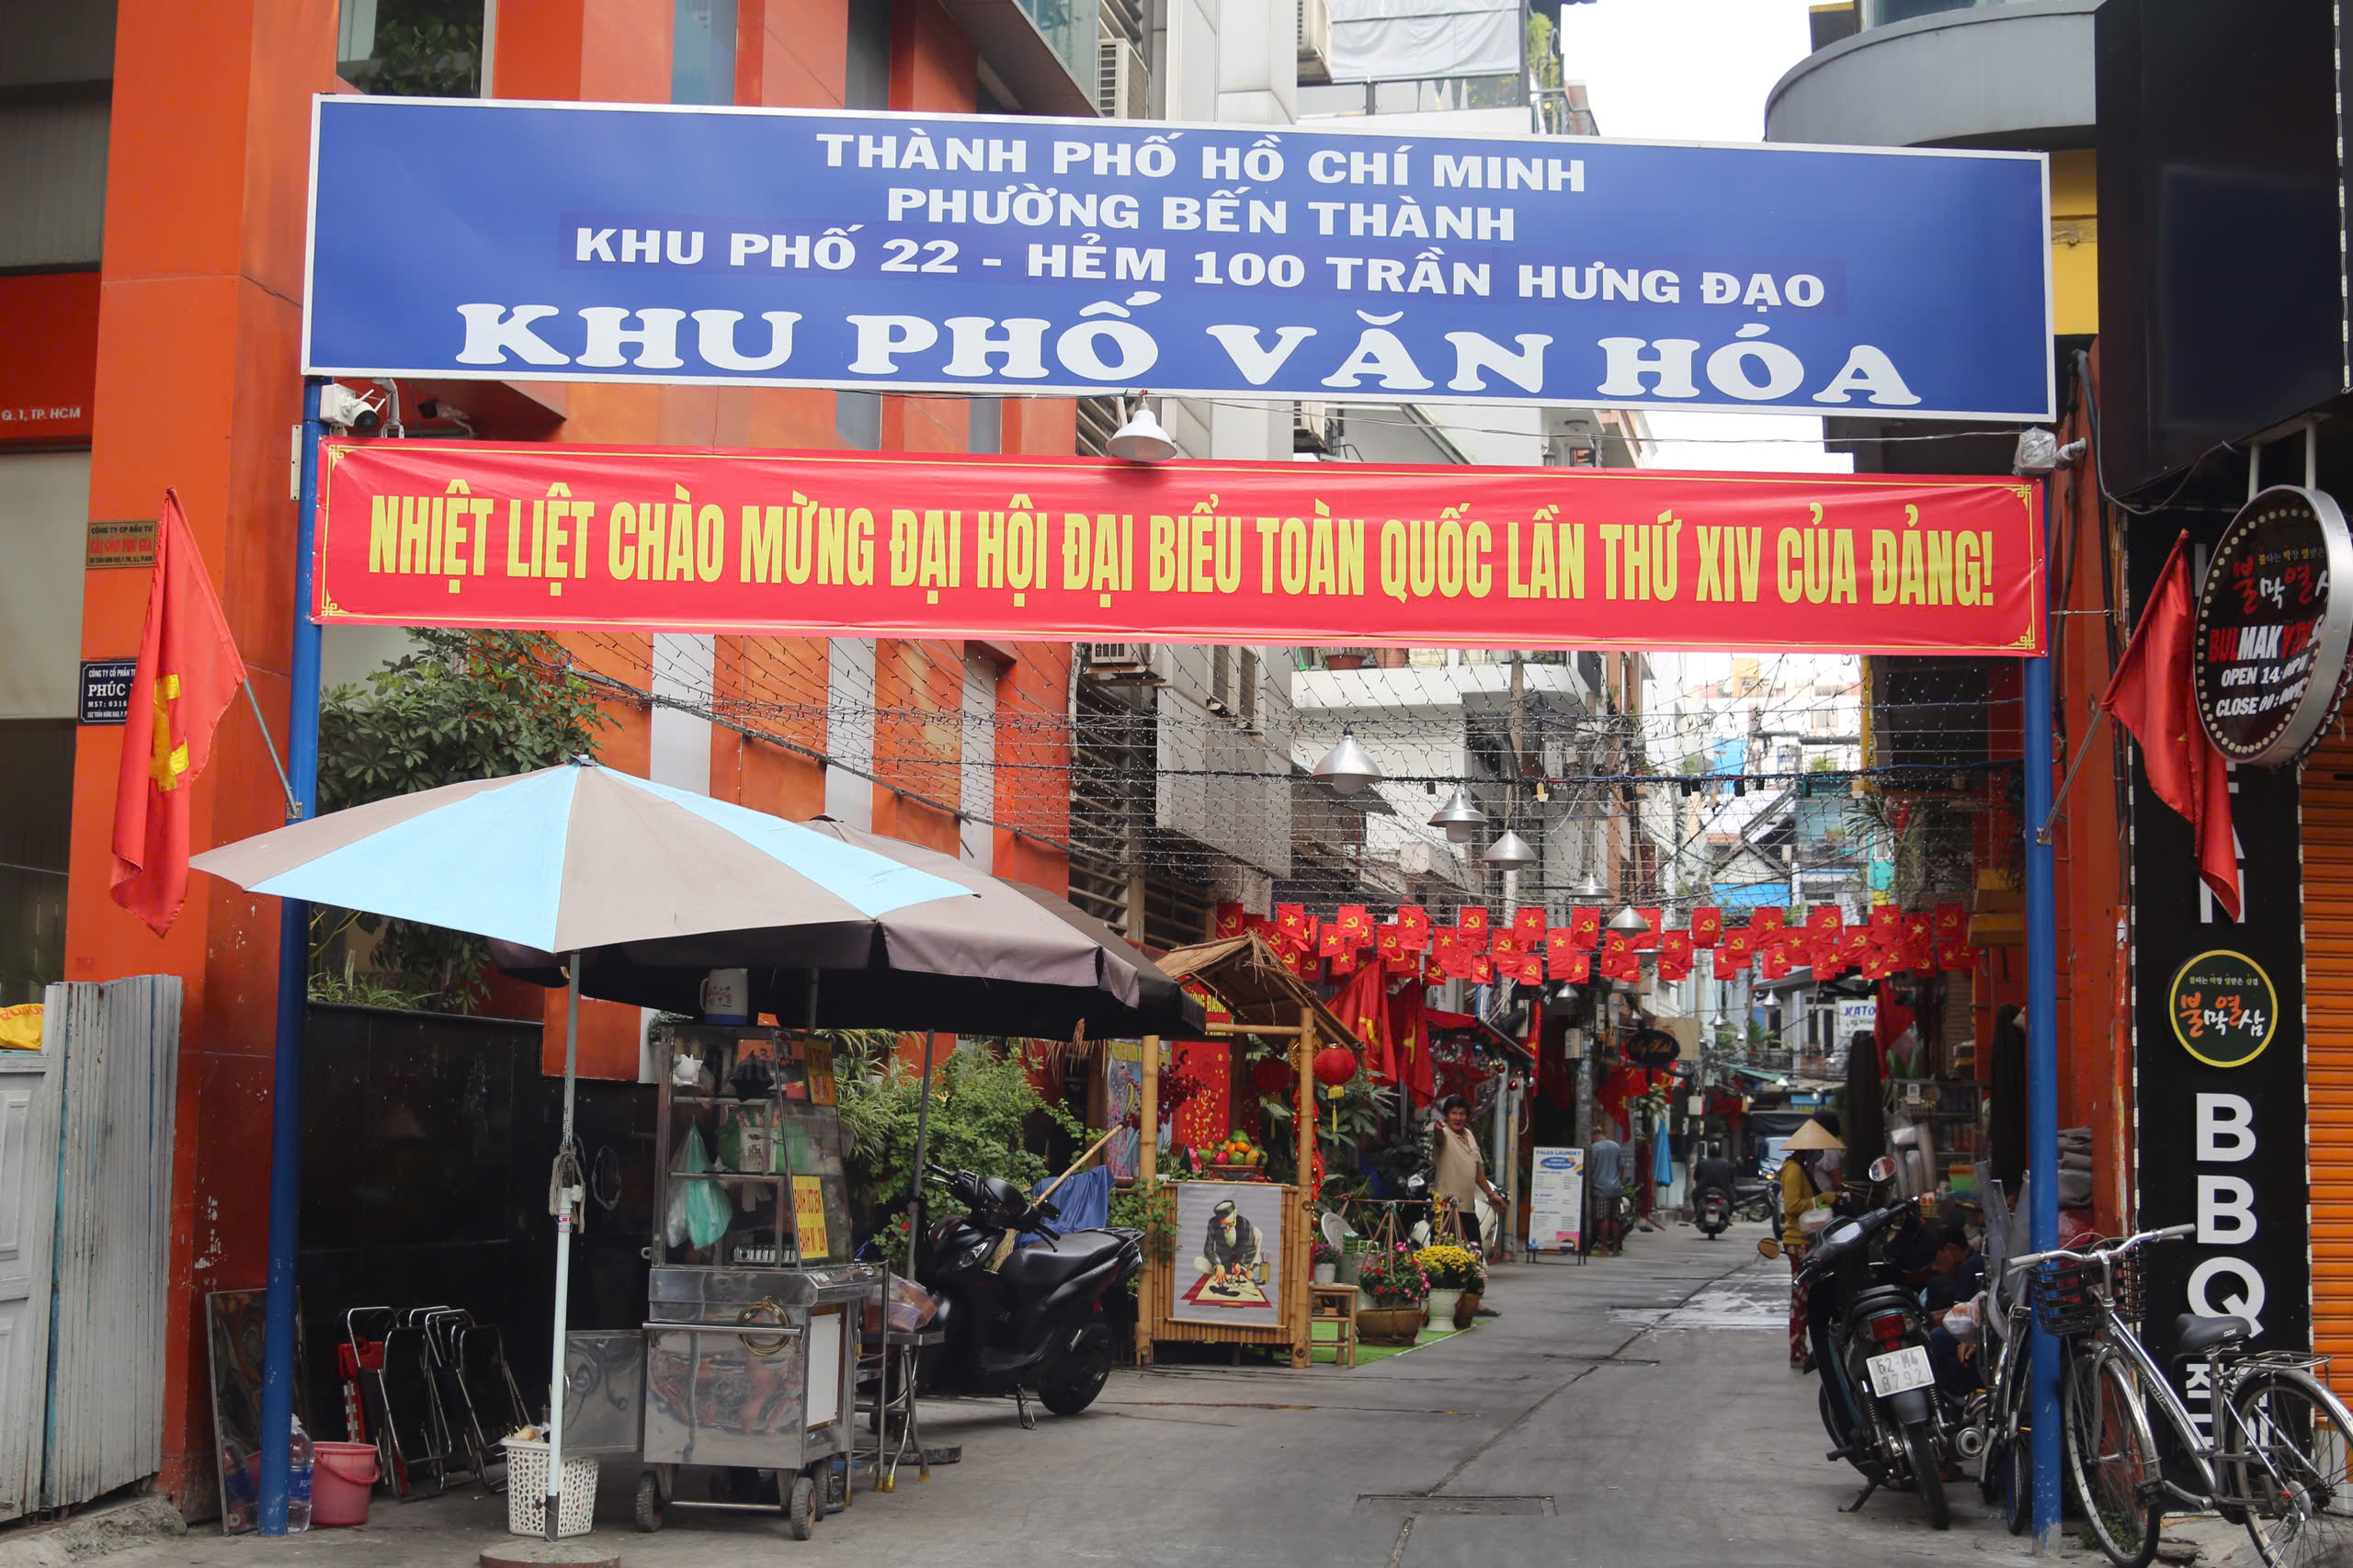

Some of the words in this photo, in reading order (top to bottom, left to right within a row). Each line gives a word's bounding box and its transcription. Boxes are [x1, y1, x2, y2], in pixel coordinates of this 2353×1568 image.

[816, 127, 1027, 173] THÀNH
[1053, 132, 1184, 177] PHỐ
[1202, 134, 1284, 181] HỒ
[1309, 145, 1414, 186] CHÍ
[1434, 154, 1585, 191] MINH
[888, 183, 1139, 229] PHƯỜNG
[1163, 187, 1286, 233] BẾN
[1308, 196, 1514, 241] THÀNH
[576, 228, 704, 264] KHU
[730, 224, 864, 269] PHỐ
[881, 239, 959, 273] 22
[1029, 233, 1165, 281] HẺM
[1195, 252, 1304, 288] 100
[1326, 247, 1490, 296] TRẦN
[1519, 261, 1679, 303] HƯNG
[1700, 272, 1824, 312] ĐẠO
[456, 303, 802, 370] KHU
[847, 291, 1162, 381] PHỐ
[1206, 310, 1553, 393] VĂN
[1597, 323, 1921, 404] HÓA
[30, 408, 46, 419] TP.
[50, 407, 81, 419] HCM
[369, 479, 494, 593] NHIỆT
[507, 483, 595, 596] LIỆT
[608, 483, 724, 582] CHÀO
[741, 490, 874, 585] MỪNG
[890, 509, 961, 604] ĐẠI
[977, 494, 1048, 607] HỘI
[1063, 513, 1132, 608] ĐẠI
[1150, 494, 1241, 593] BIỂU
[1256, 499, 1365, 595] TOÀN
[1381, 504, 1492, 603] QUỐC
[1508, 505, 1584, 598] LẦN
[1600, 509, 1682, 601] THỨ
[1697, 526, 1762, 601] XIV
[1778, 502, 1857, 603] CỦA
[1871, 505, 1993, 606] ĐẢNG!
[88, 668, 102, 677] CÔNG
[102, 669, 108, 677] TY
[88, 680, 126, 697] PHÚC
[2221, 666, 2258, 687] OPEN
[2216, 696, 2259, 718] CLOSE
[2187, 1092, 2268, 1339] BBQ
